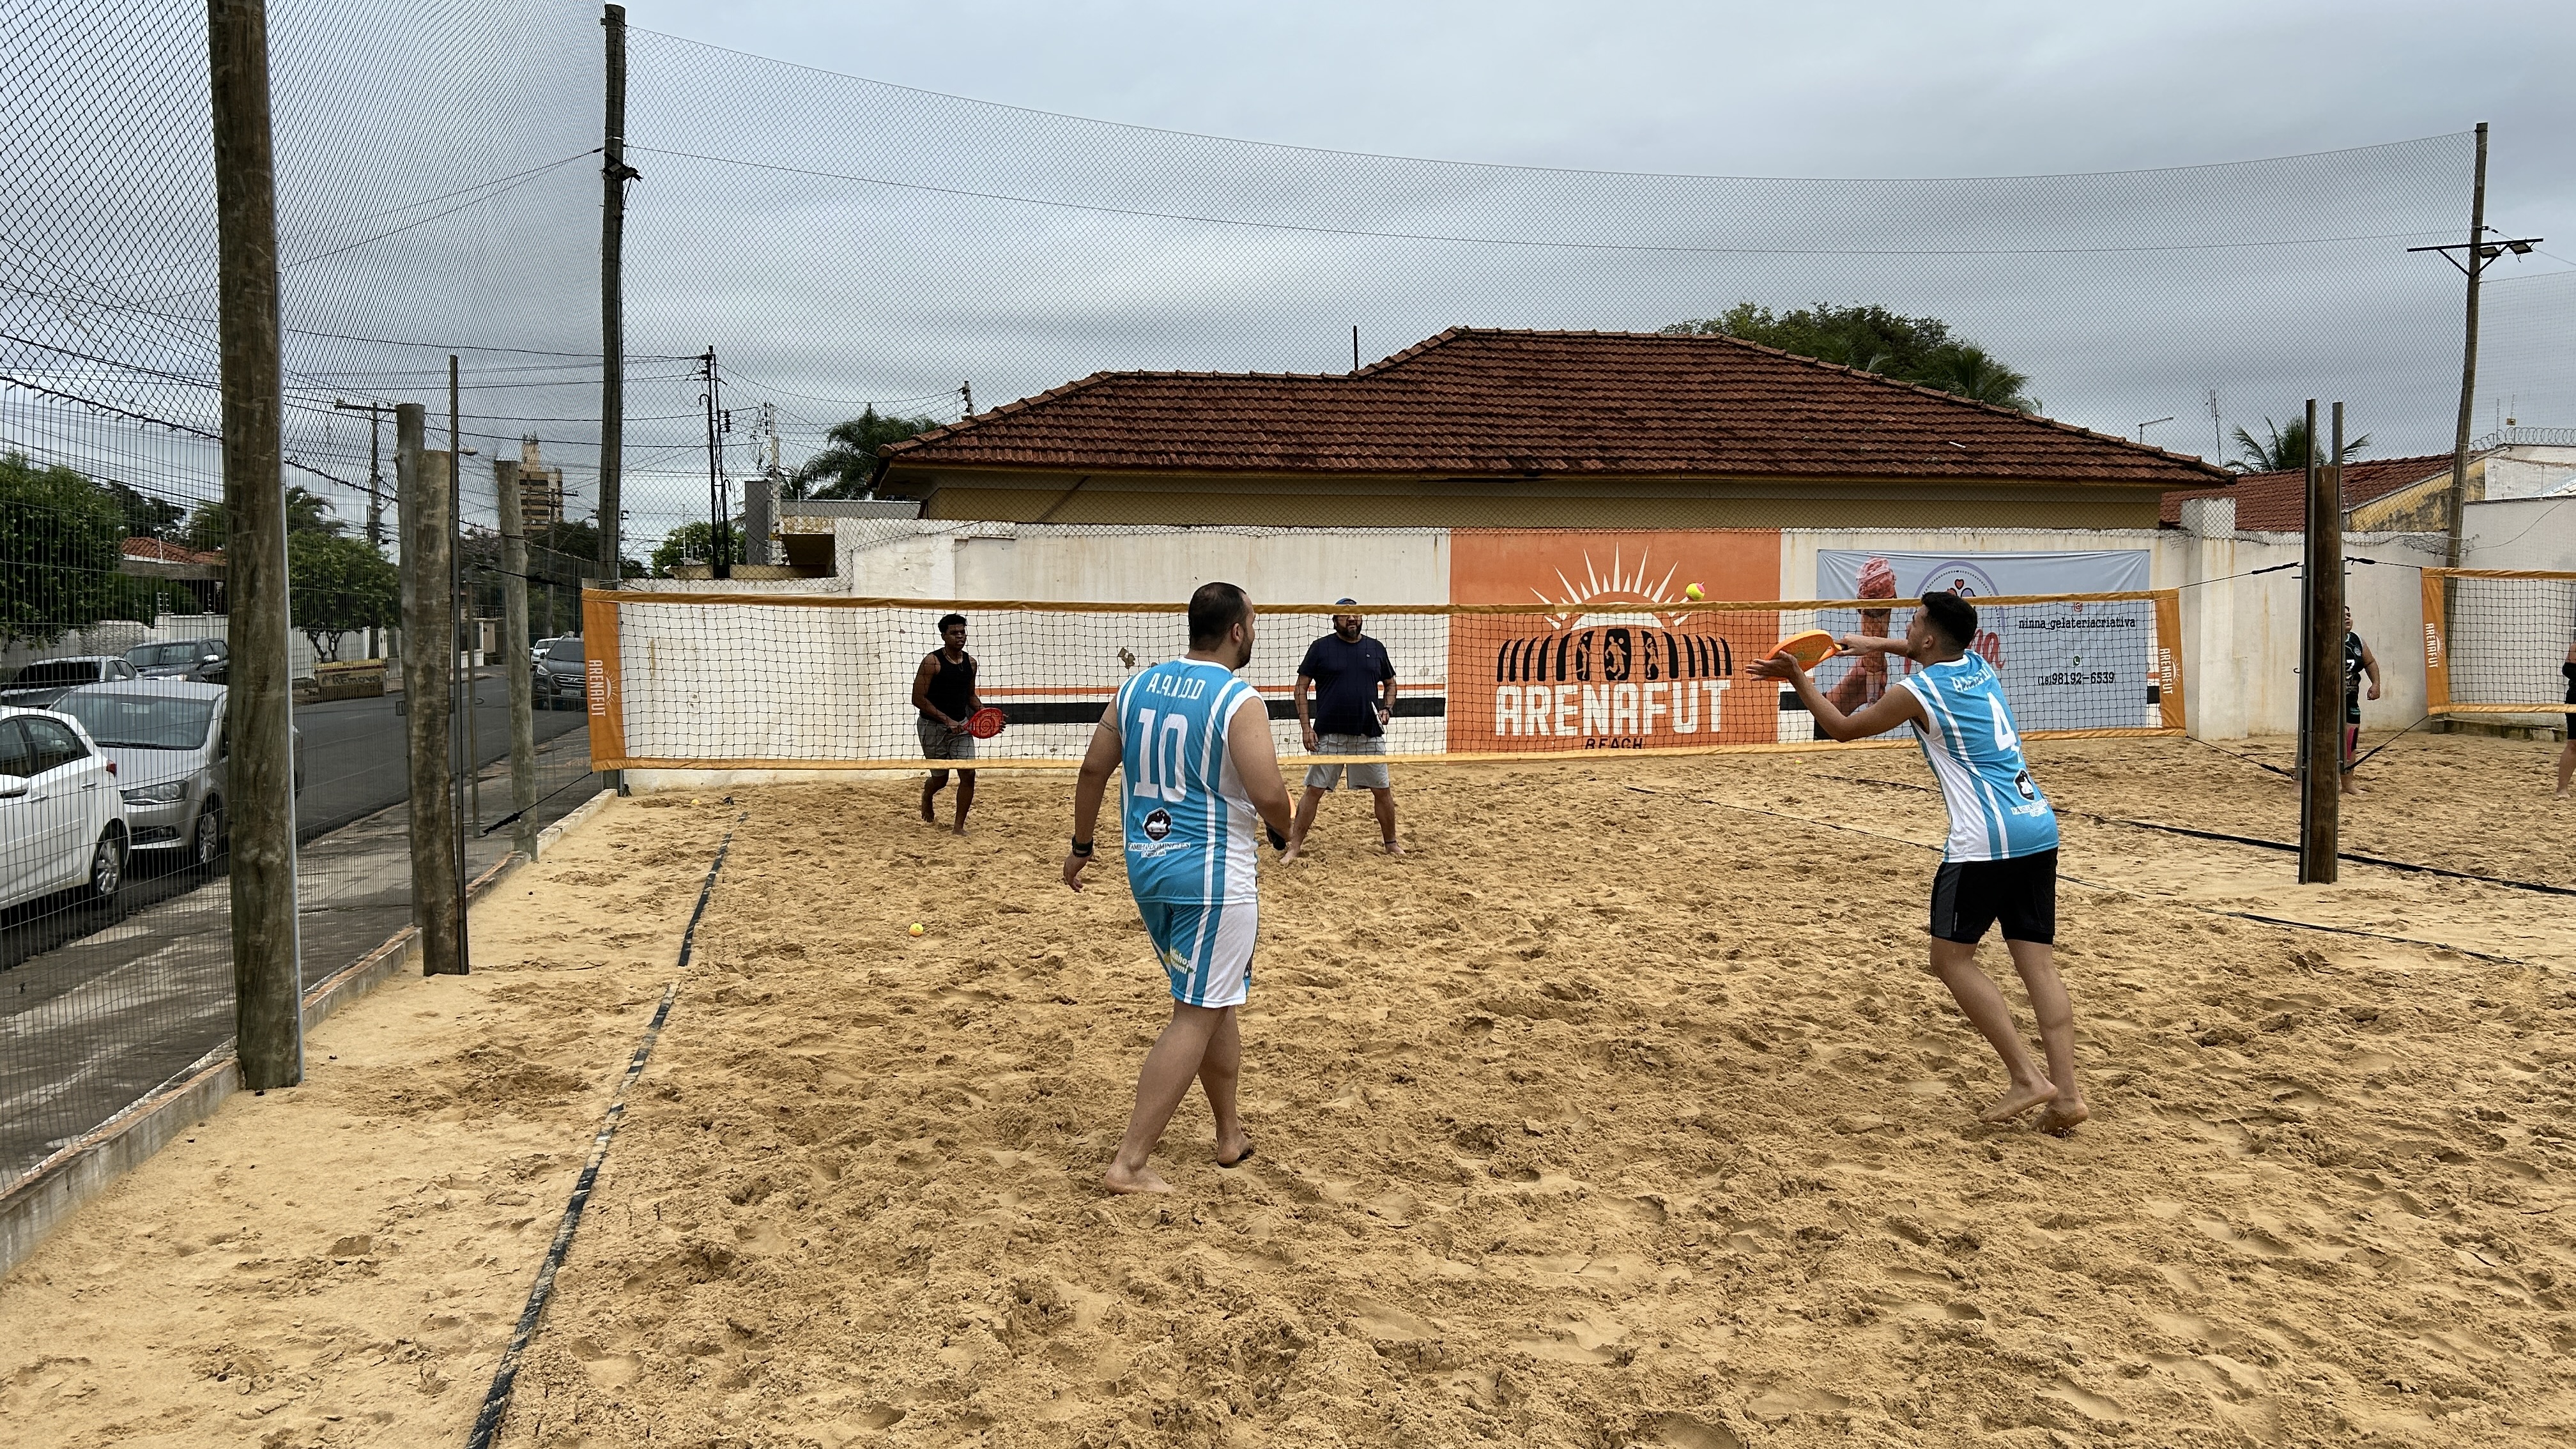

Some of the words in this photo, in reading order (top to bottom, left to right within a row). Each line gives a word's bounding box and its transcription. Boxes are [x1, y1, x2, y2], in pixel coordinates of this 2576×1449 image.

[2159, 648, 2174, 694] ARENAFUT
[2426, 623, 2439, 668] ARENAFUT
[588, 659, 606, 716] ARENAFUT
[1496, 680, 1730, 736] ARENAFUT
[1133, 707, 1188, 802] 10
[1986, 692, 2023, 763] 4
